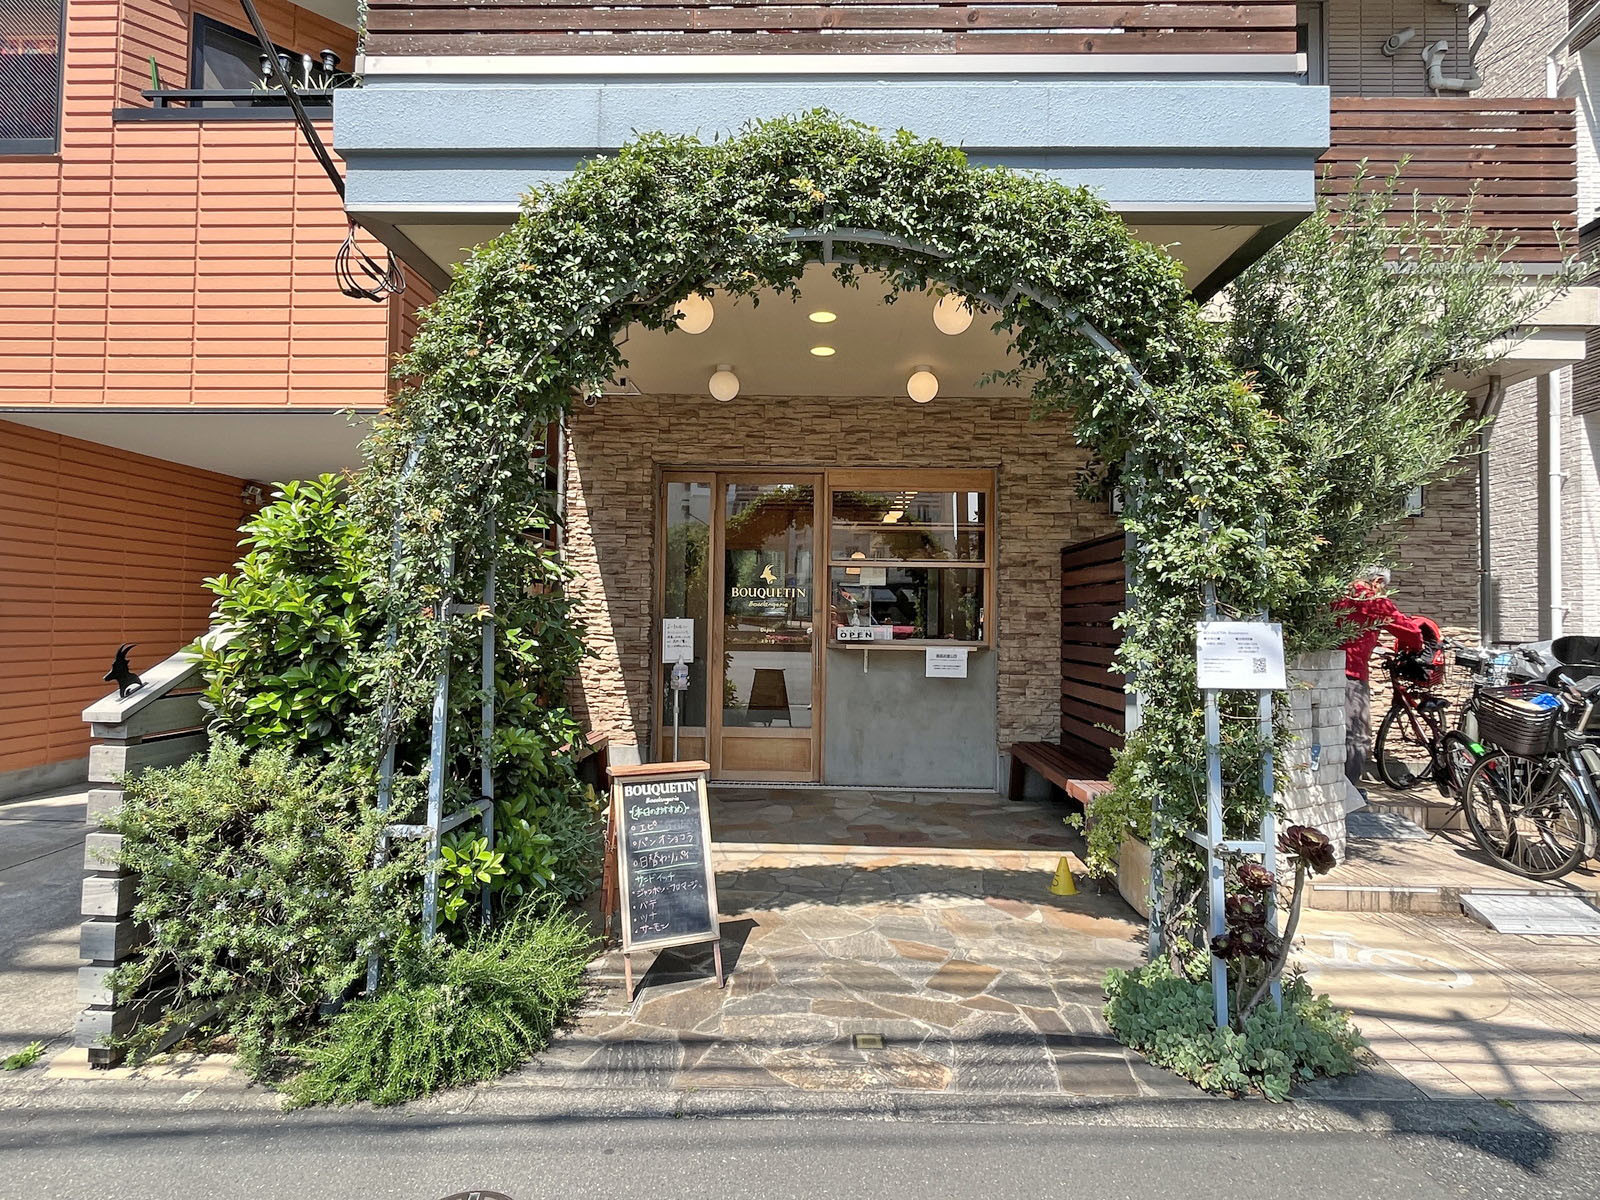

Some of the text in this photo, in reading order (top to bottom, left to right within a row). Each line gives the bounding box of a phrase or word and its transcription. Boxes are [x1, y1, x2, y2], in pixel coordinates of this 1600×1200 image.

[731, 587, 806, 599] BOUQUETIN
[748, 600, 789, 610] Boulangerie
[624, 781, 697, 797] BOUQUETIN
[640, 911, 657, 923] ツナ
[639, 922, 670, 934] サーモン
